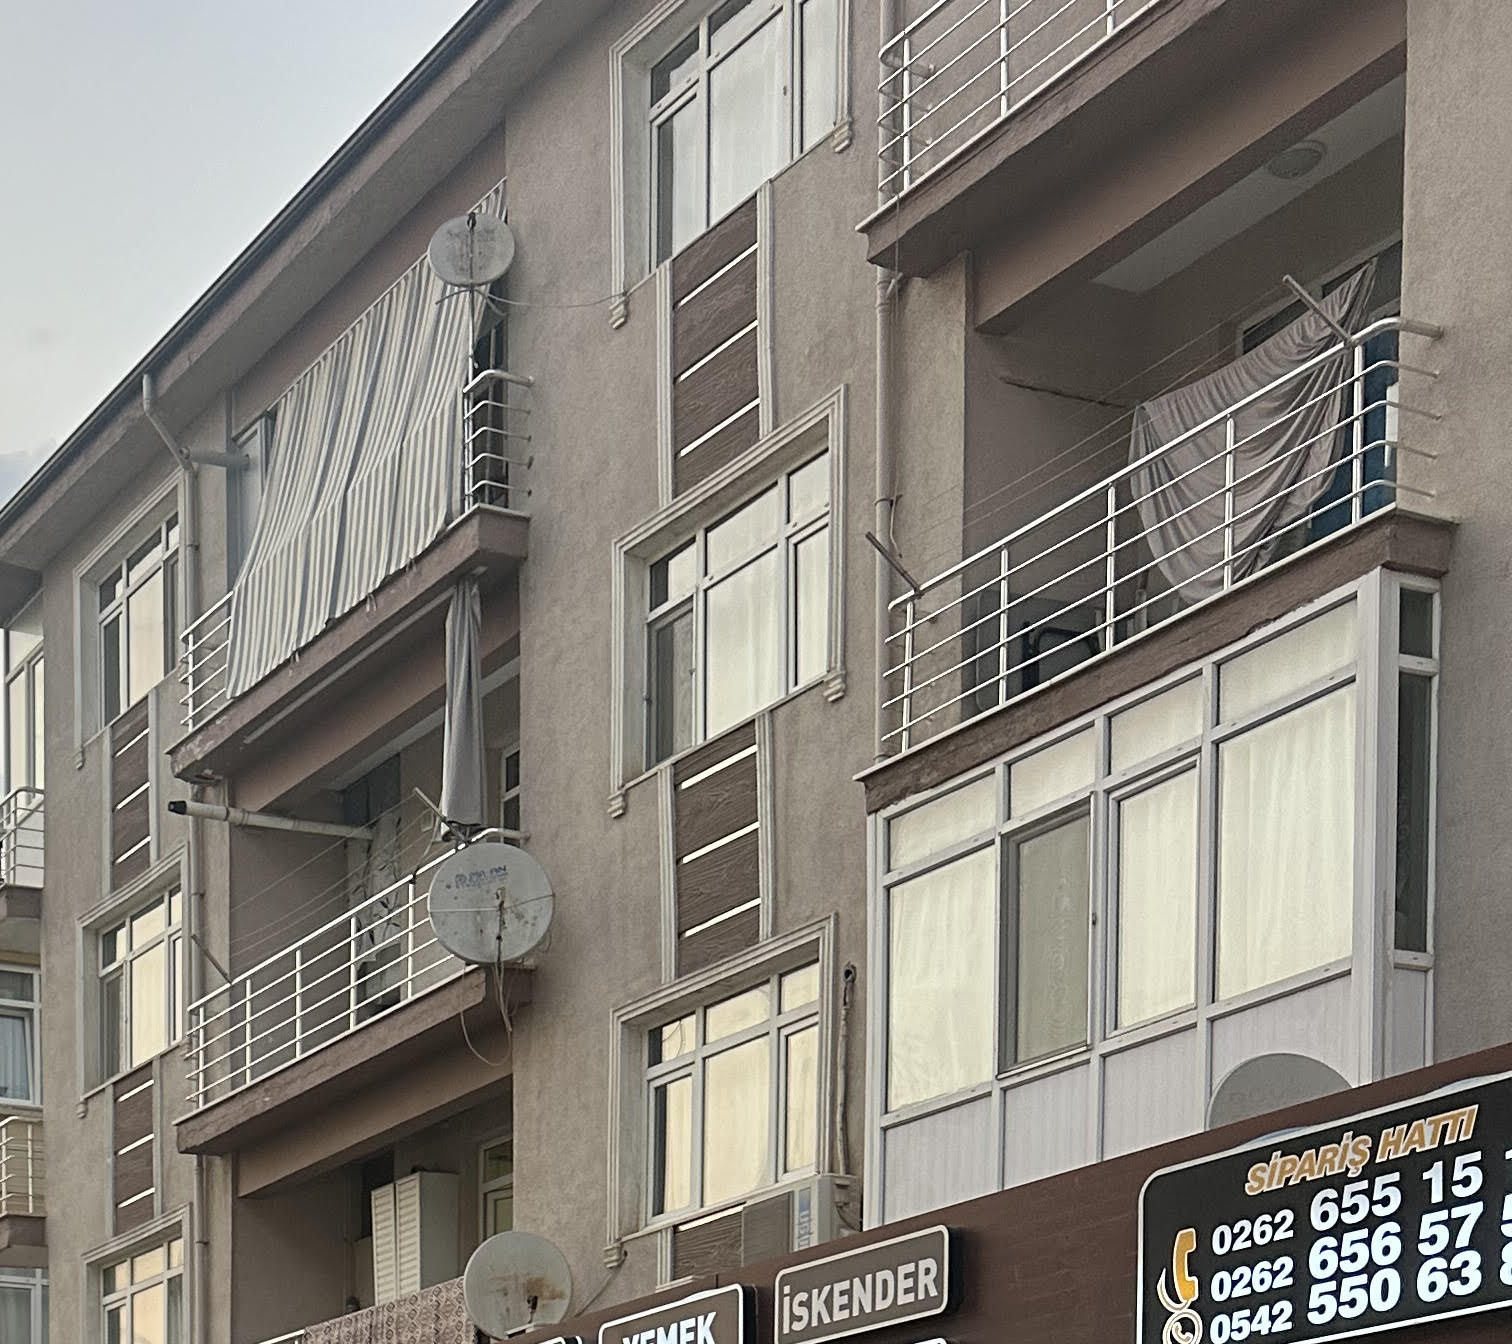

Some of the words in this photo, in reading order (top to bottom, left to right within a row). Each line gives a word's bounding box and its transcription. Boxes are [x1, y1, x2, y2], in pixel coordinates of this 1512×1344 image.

[1244, 1130, 1373, 1196] SİPARİŞ
[1375, 1104, 1479, 1163] HATTI
[1212, 1209, 1294, 1255] 0262
[1310, 1172, 1401, 1231] 655
[1422, 1151, 1483, 1203] 15
[782, 1258, 939, 1335] İSKENDER
[1209, 1300, 1293, 1344] 0542
[1307, 1268, 1401, 1325] 550
[1416, 1250, 1482, 1301] 63
[1210, 1256, 1294, 1301] 0262
[1308, 1221, 1401, 1280] 656
[1418, 1201, 1484, 1256] 57
